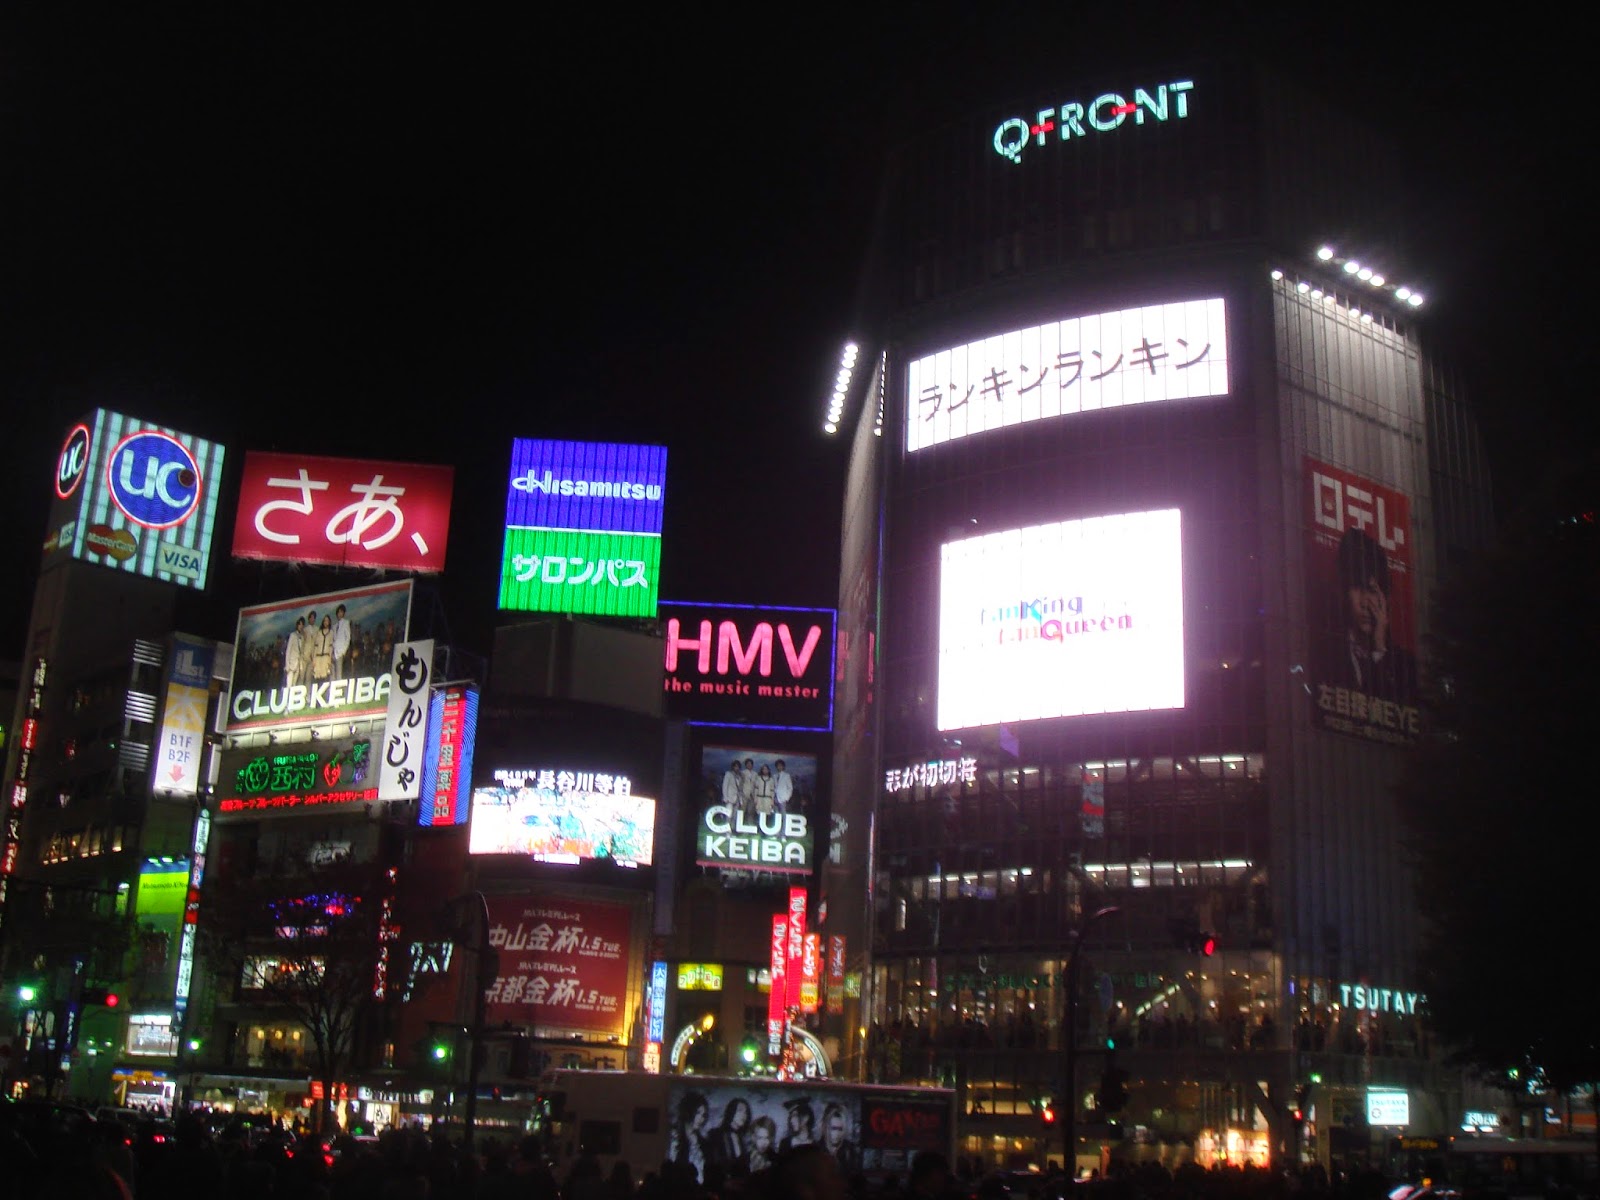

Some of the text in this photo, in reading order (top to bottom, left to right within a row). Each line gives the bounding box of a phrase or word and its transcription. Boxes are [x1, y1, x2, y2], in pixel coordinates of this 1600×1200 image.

[993, 80, 1194, 165] QFRONT
[919, 337, 1211, 422] ランキンランキン
[255, 468, 430, 556] さあ、
[163, 547, 200, 572] VISA
[511, 553, 649, 589] サロンパス
[665, 617, 822, 679] HMV
[233, 672, 392, 721] CLUB KEIBA
[664, 677, 820, 699] the music master
[386, 646, 429, 793] もんじゃ
[168, 748, 191, 763] B2F
[170, 733, 192, 748] B1F
[537, 769, 632, 797] 長谷川等伯
[705, 804, 808, 838] CLUB
[705, 834, 806, 865] KEIBA
[488, 922, 584, 955] 中山金杯
[1340, 983, 1430, 1016] TSUTAY
